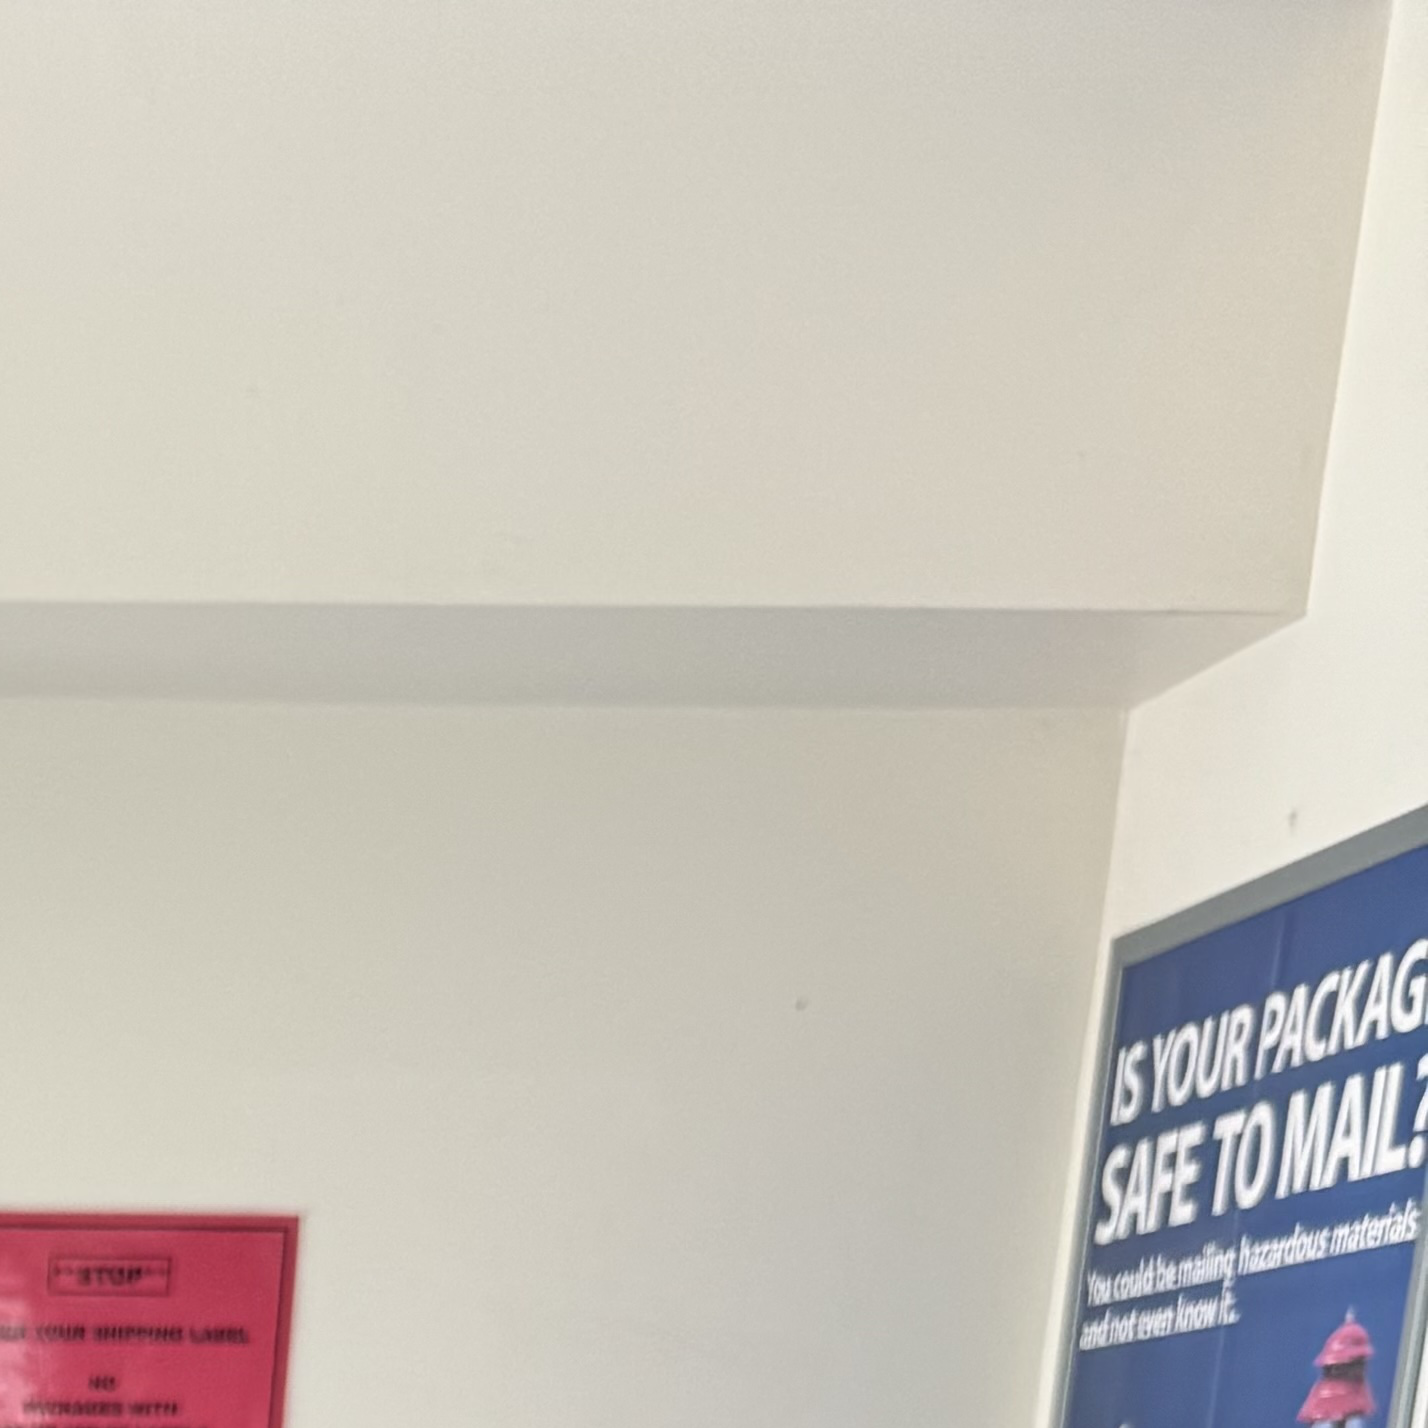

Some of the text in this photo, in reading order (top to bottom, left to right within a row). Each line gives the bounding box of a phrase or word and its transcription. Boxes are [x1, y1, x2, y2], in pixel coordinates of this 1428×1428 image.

[1110, 938, 1428, 1127] IS YOUR PACKAG
[1094, 1053, 1428, 1246] SAFE TO MAIL?
[1079, 1307, 1110, 1351] and
[1110, 1308, 1137, 1345] not
[1137, 1305, 1174, 1340] even
[1175, 1293, 1219, 1333] know
[1087, 1197, 1421, 1306] You could be mailing hazardous materials
